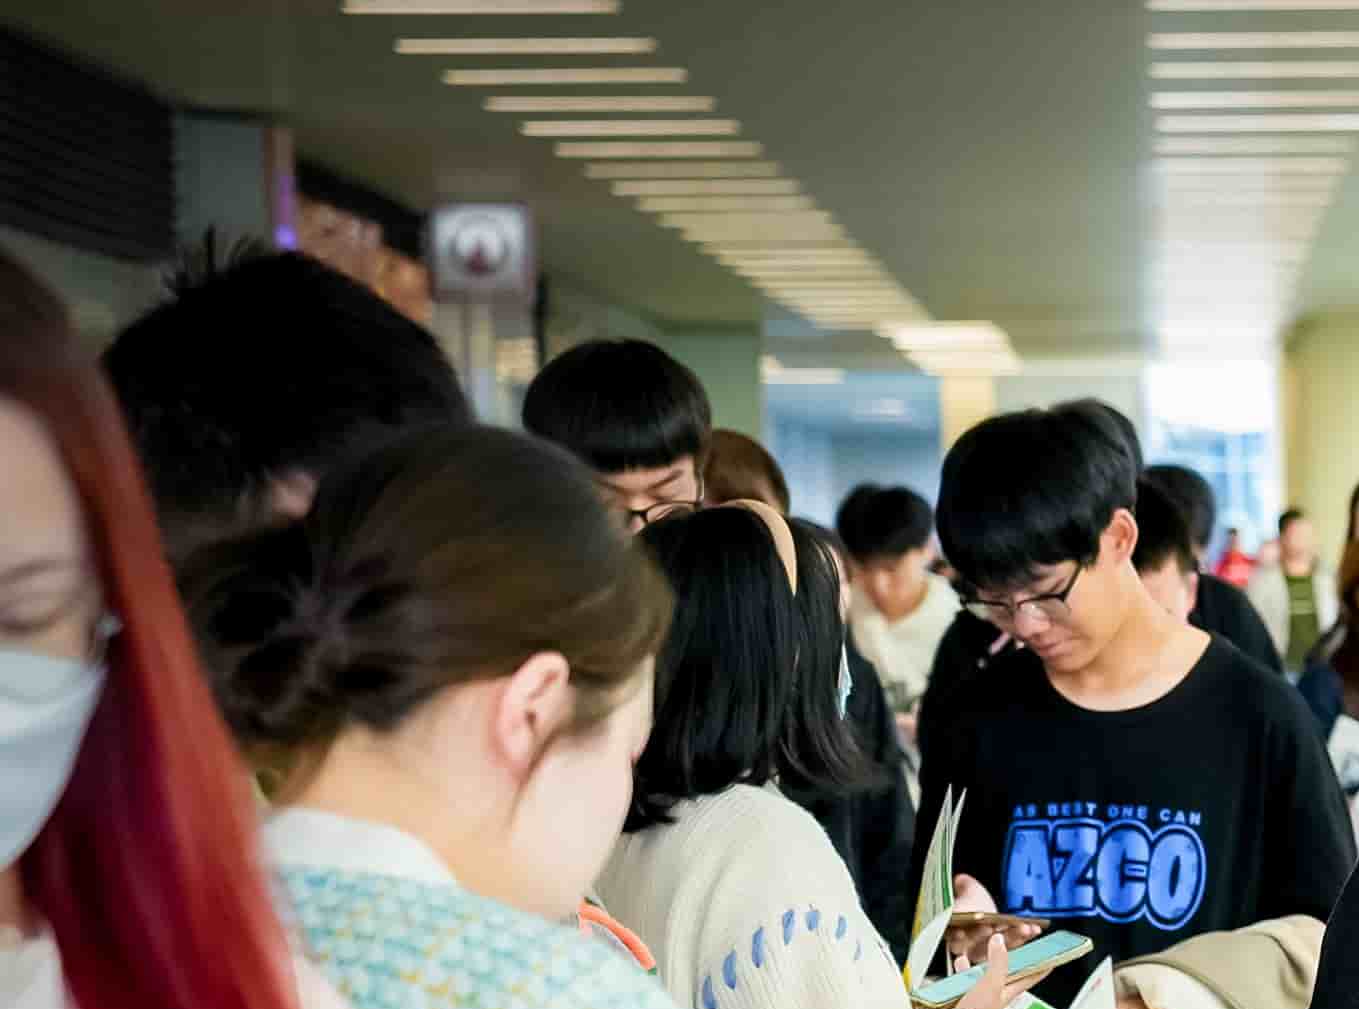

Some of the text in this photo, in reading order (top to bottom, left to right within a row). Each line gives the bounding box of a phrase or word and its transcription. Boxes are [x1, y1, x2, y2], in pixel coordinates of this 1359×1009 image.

[1107, 803, 1148, 819] ONE
[1159, 808, 1201, 826] CAN
[1003, 817, 1207, 930] AZCO
